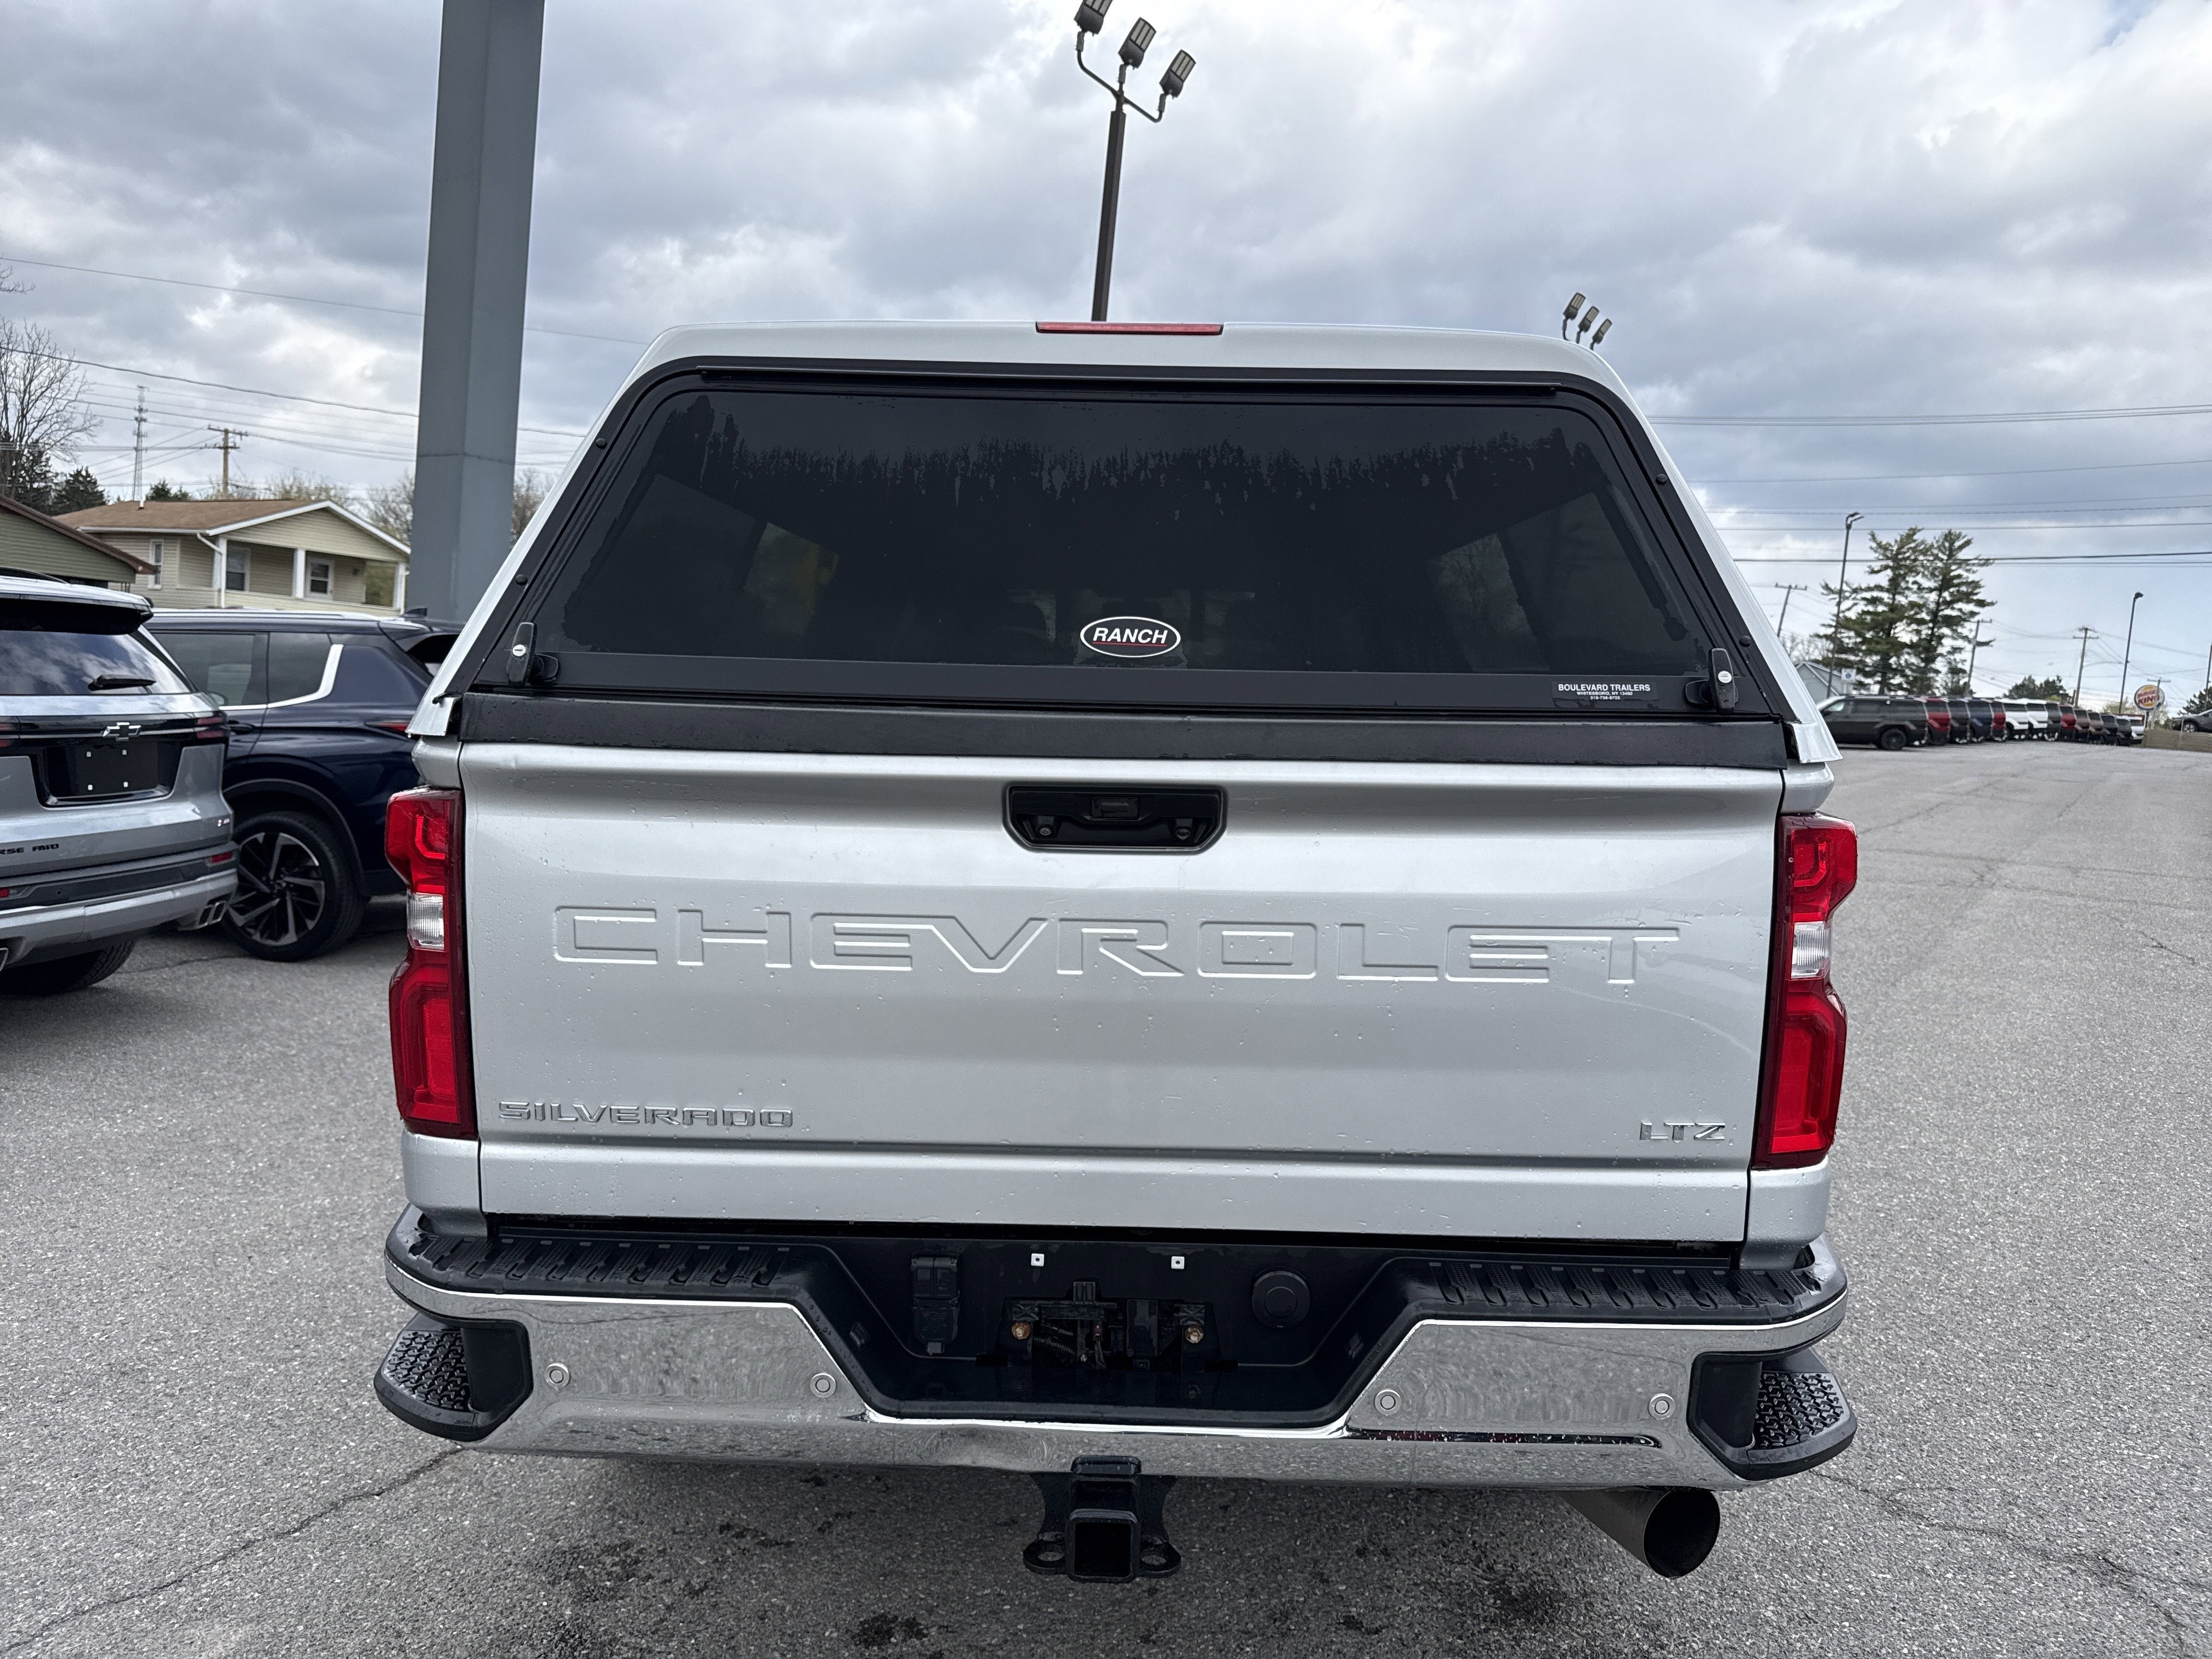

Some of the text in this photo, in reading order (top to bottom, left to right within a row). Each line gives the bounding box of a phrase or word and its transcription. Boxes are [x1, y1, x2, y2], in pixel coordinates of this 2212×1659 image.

[1093, 627, 1168, 644] RANCH
[552, 905, 1680, 985] CHEVROLET
[499, 1101, 793, 1128] SILVERADO
[1640, 1122, 1725, 1141] LTZ
